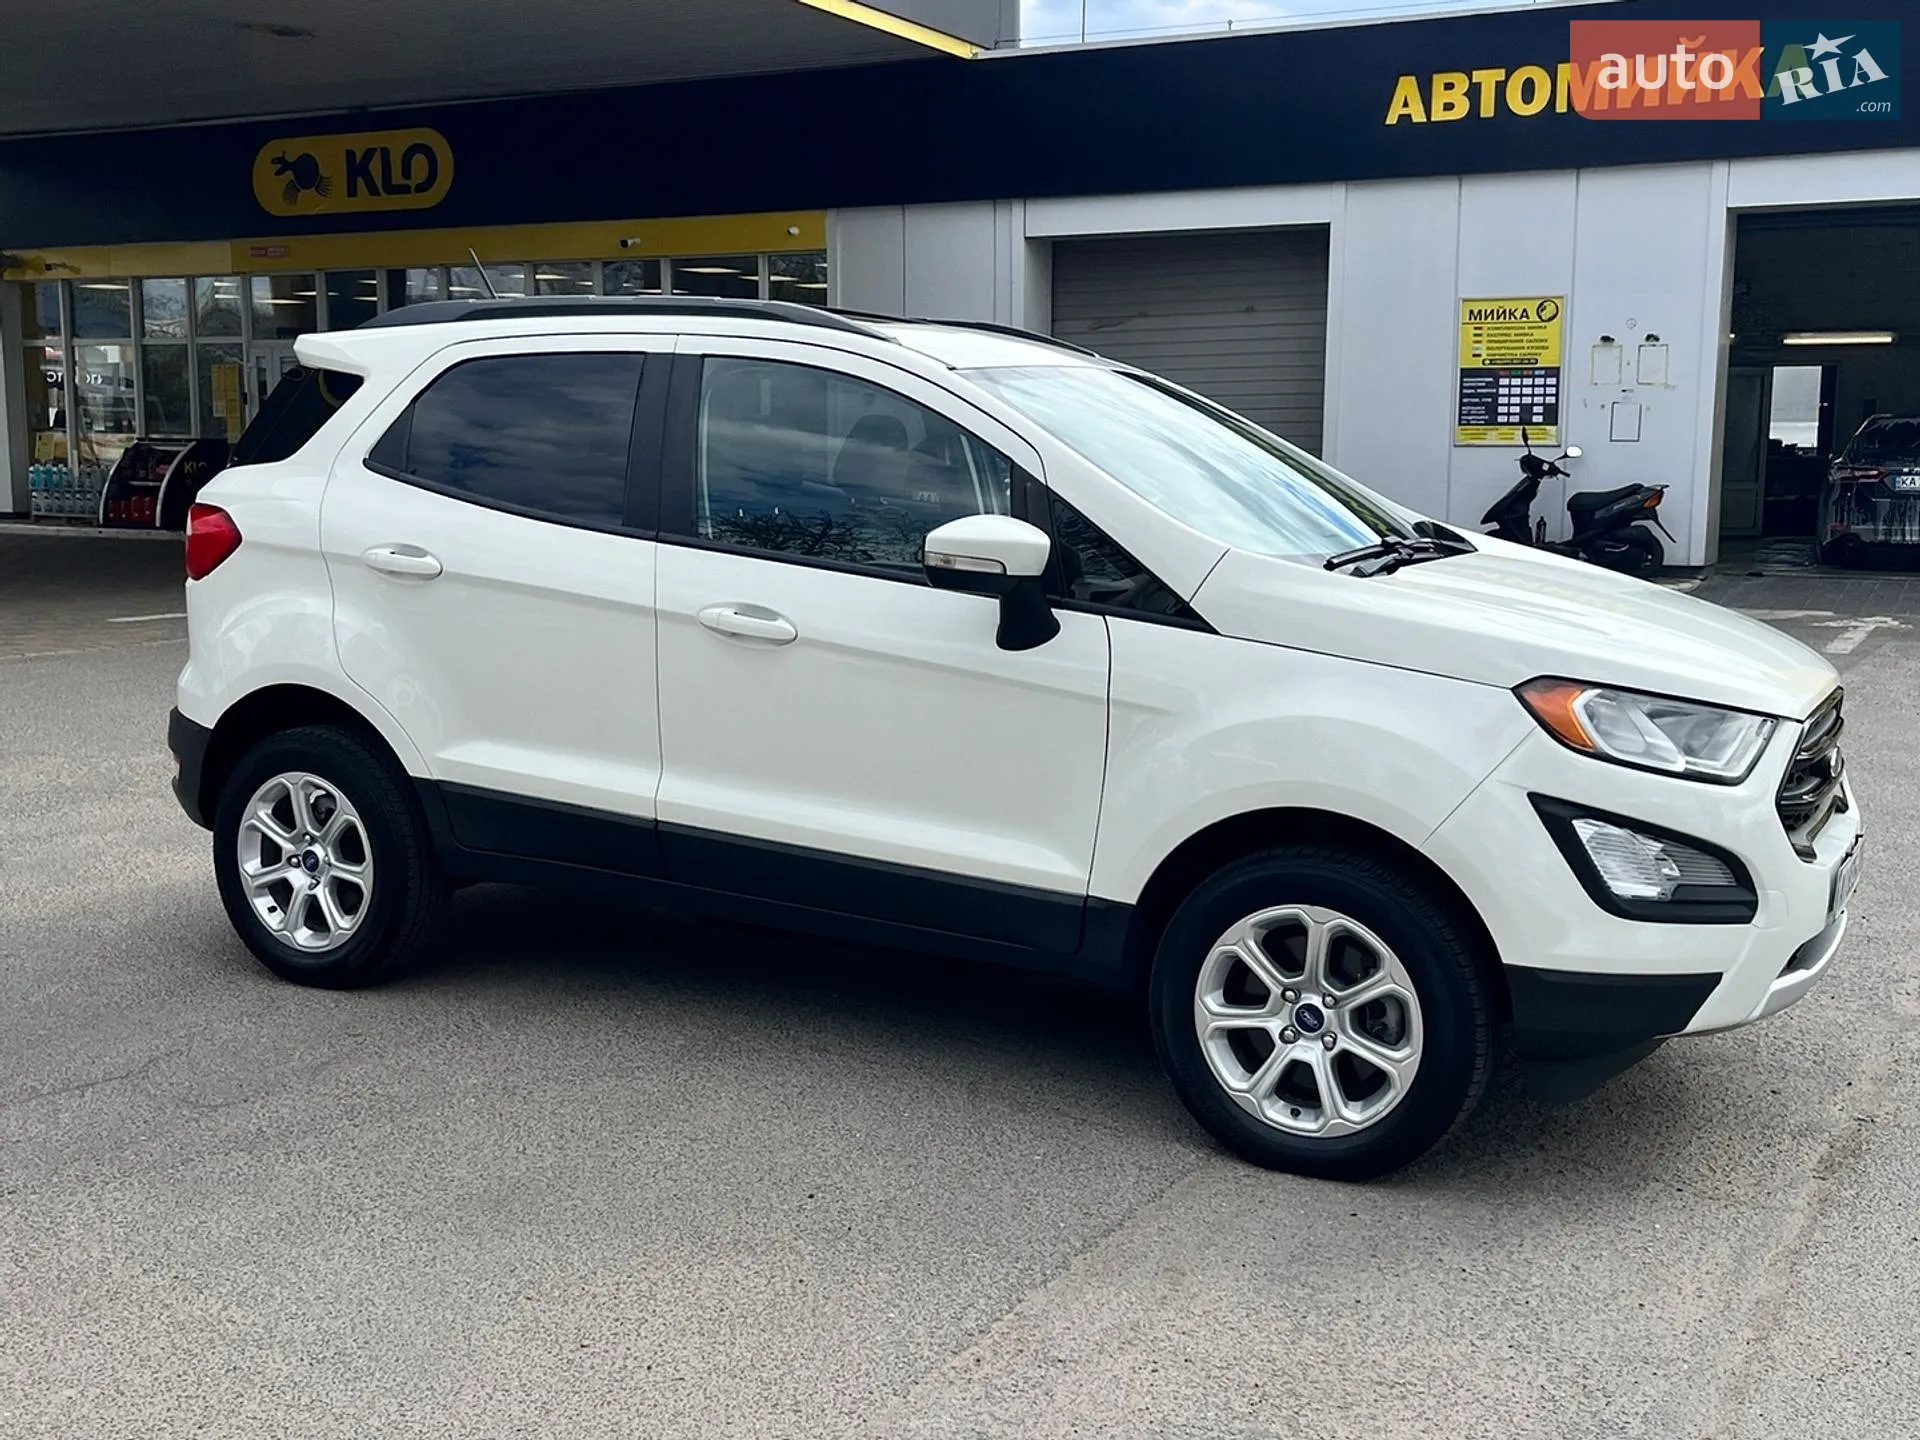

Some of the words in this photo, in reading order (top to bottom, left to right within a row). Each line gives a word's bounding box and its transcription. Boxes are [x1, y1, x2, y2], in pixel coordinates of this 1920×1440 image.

[1385, 35, 1817, 125] АВТОМИЙКА
[344, 143, 438, 198] KLO
[1468, 305, 1530, 321] МИЙКА
